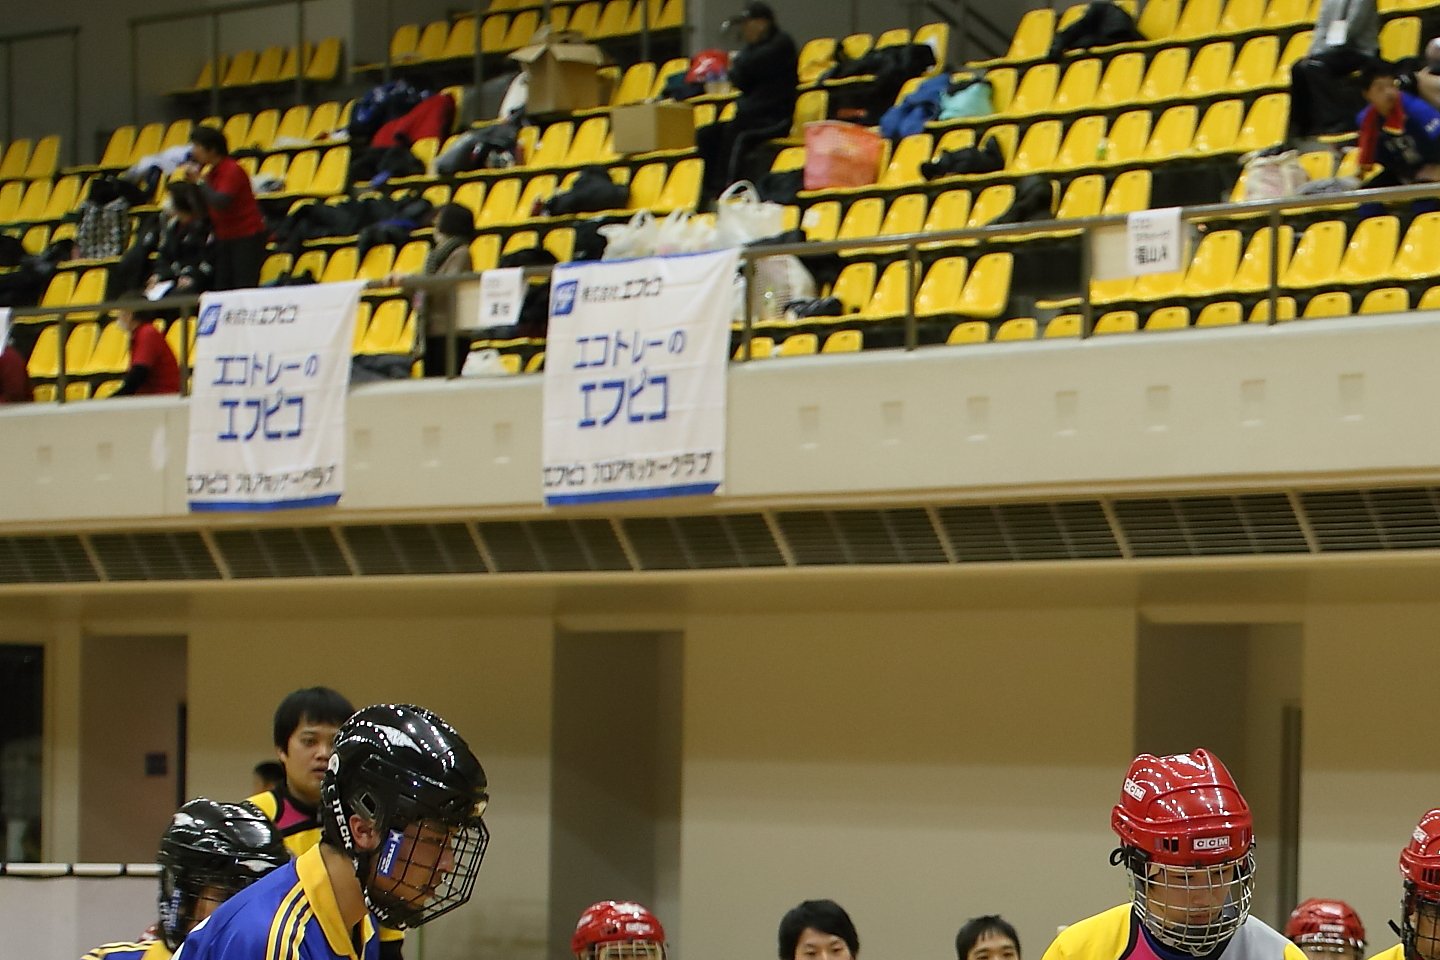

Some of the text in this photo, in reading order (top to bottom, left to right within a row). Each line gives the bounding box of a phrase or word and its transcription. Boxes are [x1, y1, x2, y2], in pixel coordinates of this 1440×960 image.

[211, 352, 319, 386] エコトレーの
[573, 329, 687, 369] エコトレーの
[217, 387, 305, 441] エフピコ
[577, 367, 669, 429] エフピコ
[1195, 836, 1229, 849] CCM
